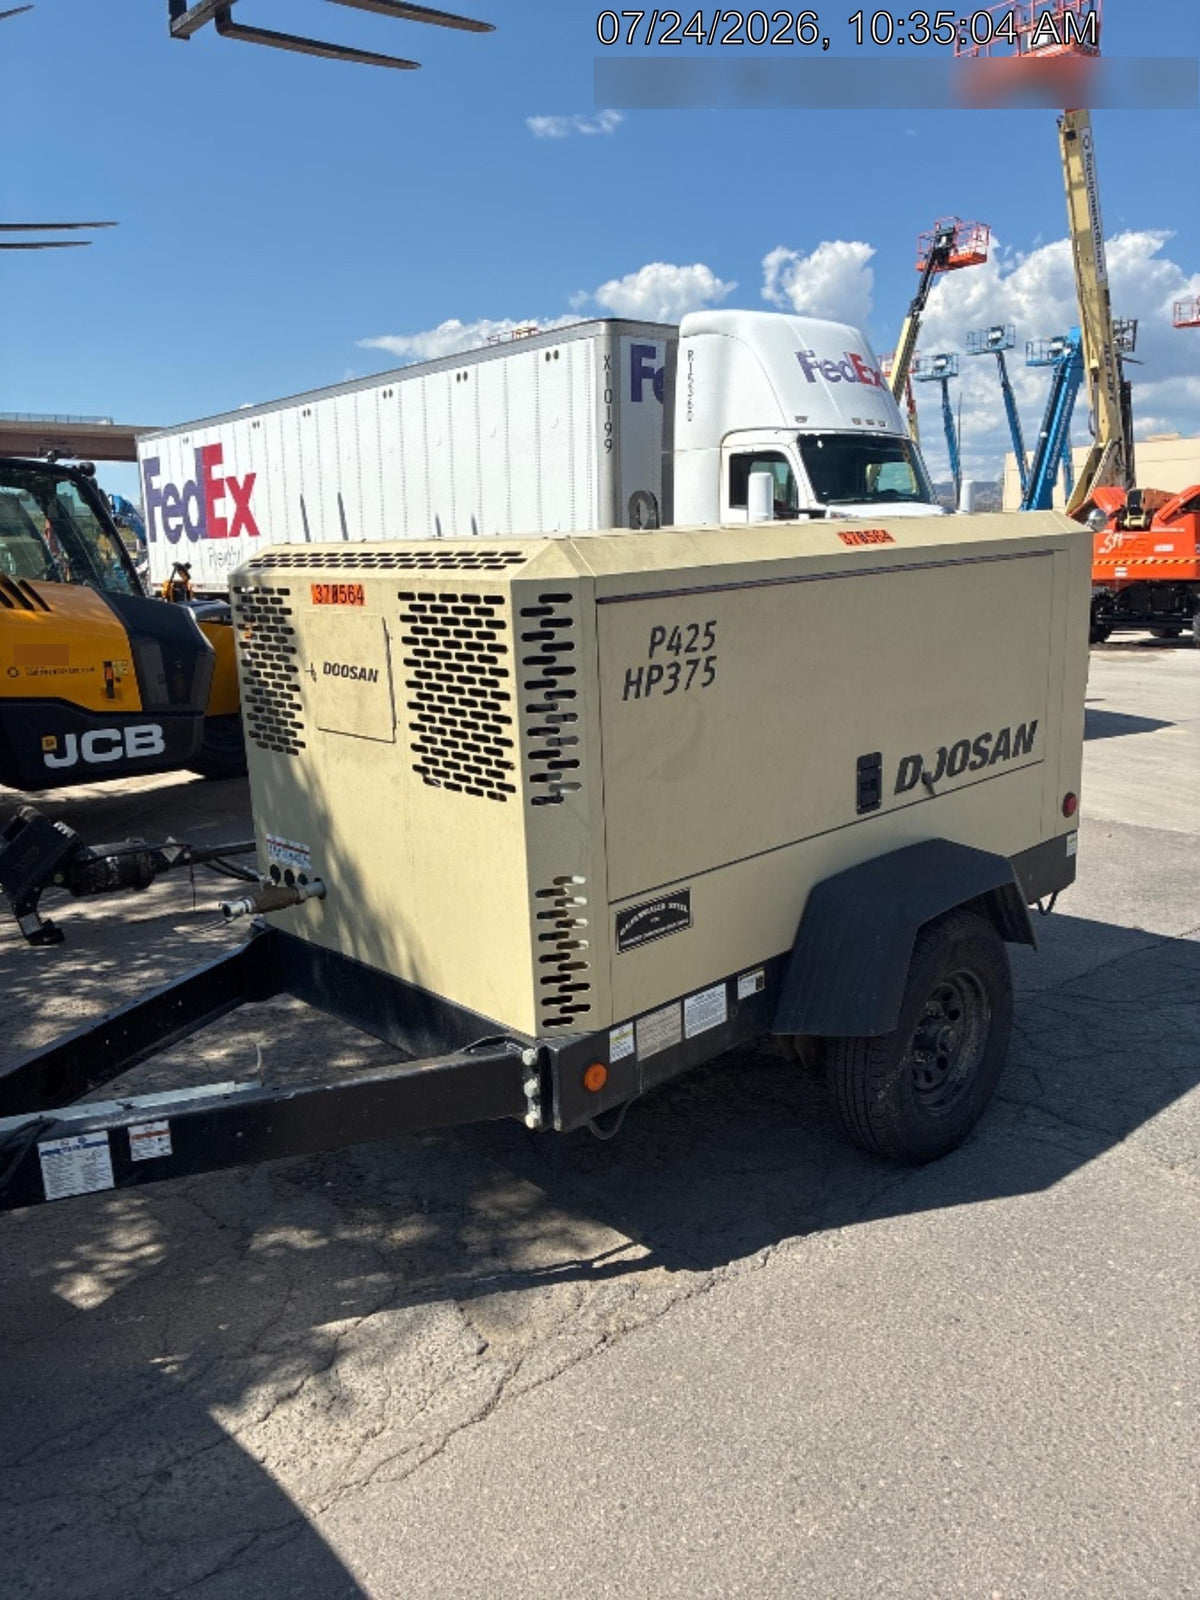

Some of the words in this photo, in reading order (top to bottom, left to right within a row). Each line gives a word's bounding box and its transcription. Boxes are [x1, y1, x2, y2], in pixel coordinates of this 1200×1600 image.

[142, 442, 260, 544] FedEx
[315, 583, 366, 605] 370564
[648, 619, 718, 659] P425
[322, 660, 379, 684] DOOSAN
[622, 655, 718, 701] HP375
[43, 723, 166, 769] JCB
